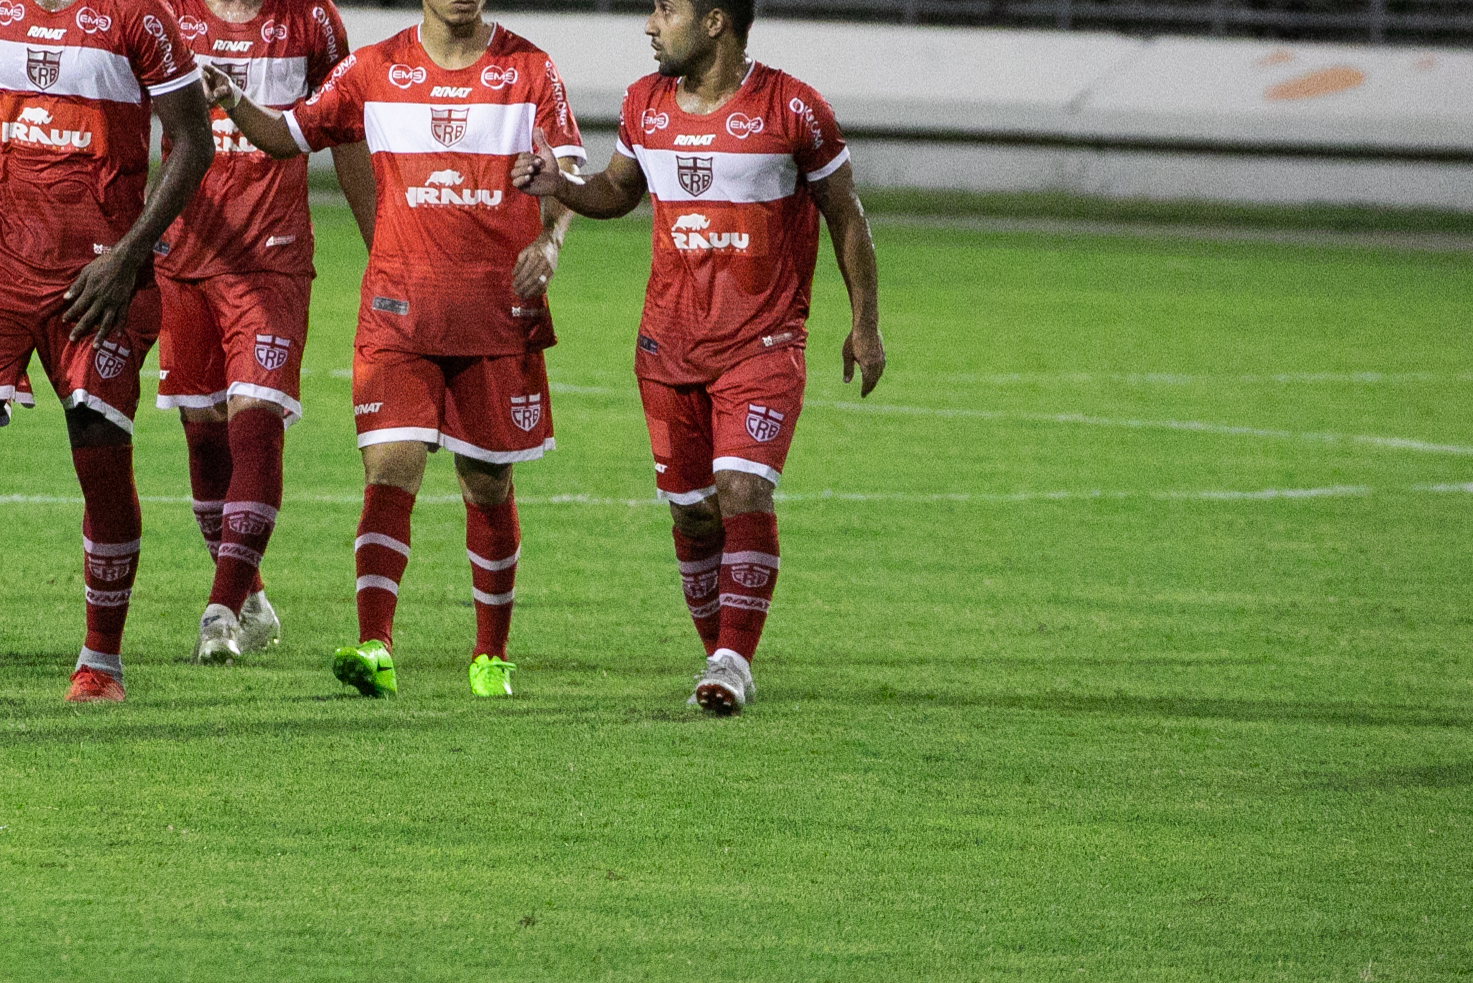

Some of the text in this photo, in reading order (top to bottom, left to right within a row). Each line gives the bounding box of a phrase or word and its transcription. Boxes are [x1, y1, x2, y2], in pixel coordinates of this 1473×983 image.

[26, 26, 67, 40] RINAT
[212, 39, 253, 52] RINAT
[158, 34, 178, 76] KRON
[429, 86, 472, 98] RINAT
[673, 133, 716, 146] RINAT
[670, 231, 749, 250] RAUU
